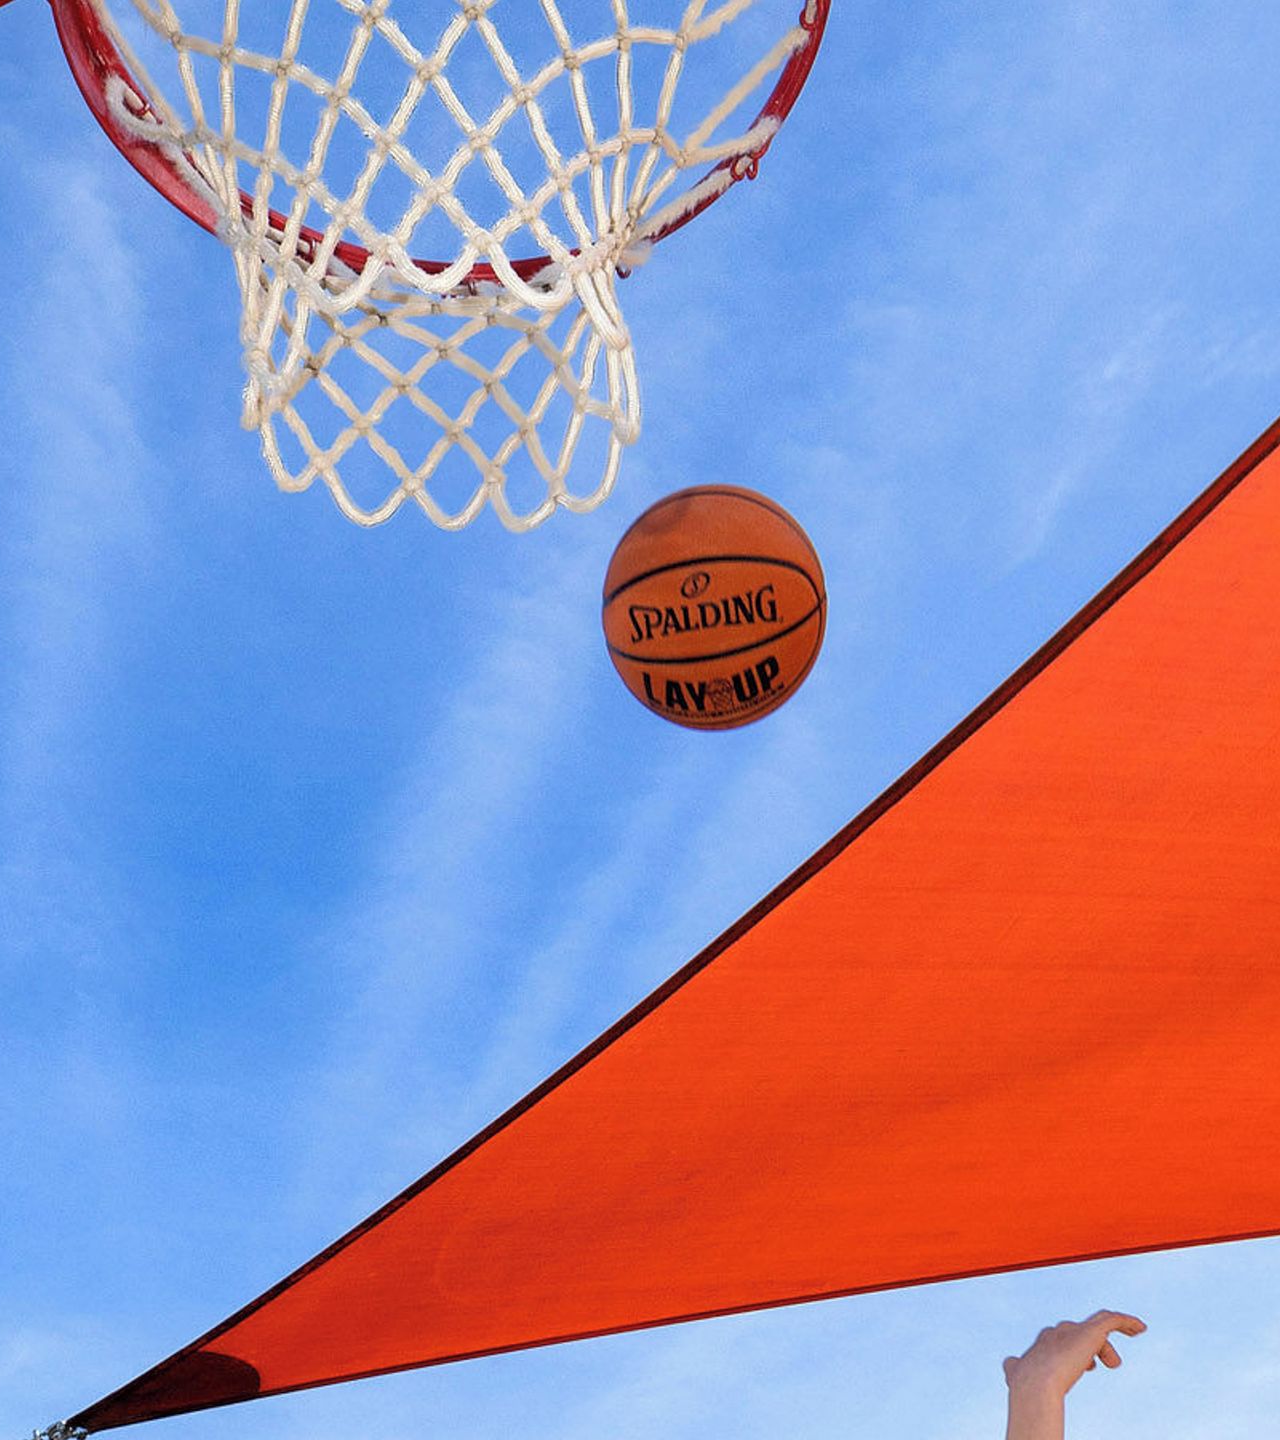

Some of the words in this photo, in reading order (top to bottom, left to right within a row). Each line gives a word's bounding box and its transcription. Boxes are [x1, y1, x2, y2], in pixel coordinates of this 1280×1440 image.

[628, 584, 779, 644] SPALDING
[642, 671, 707, 711] LAY
[731, 655, 780, 702] UP
